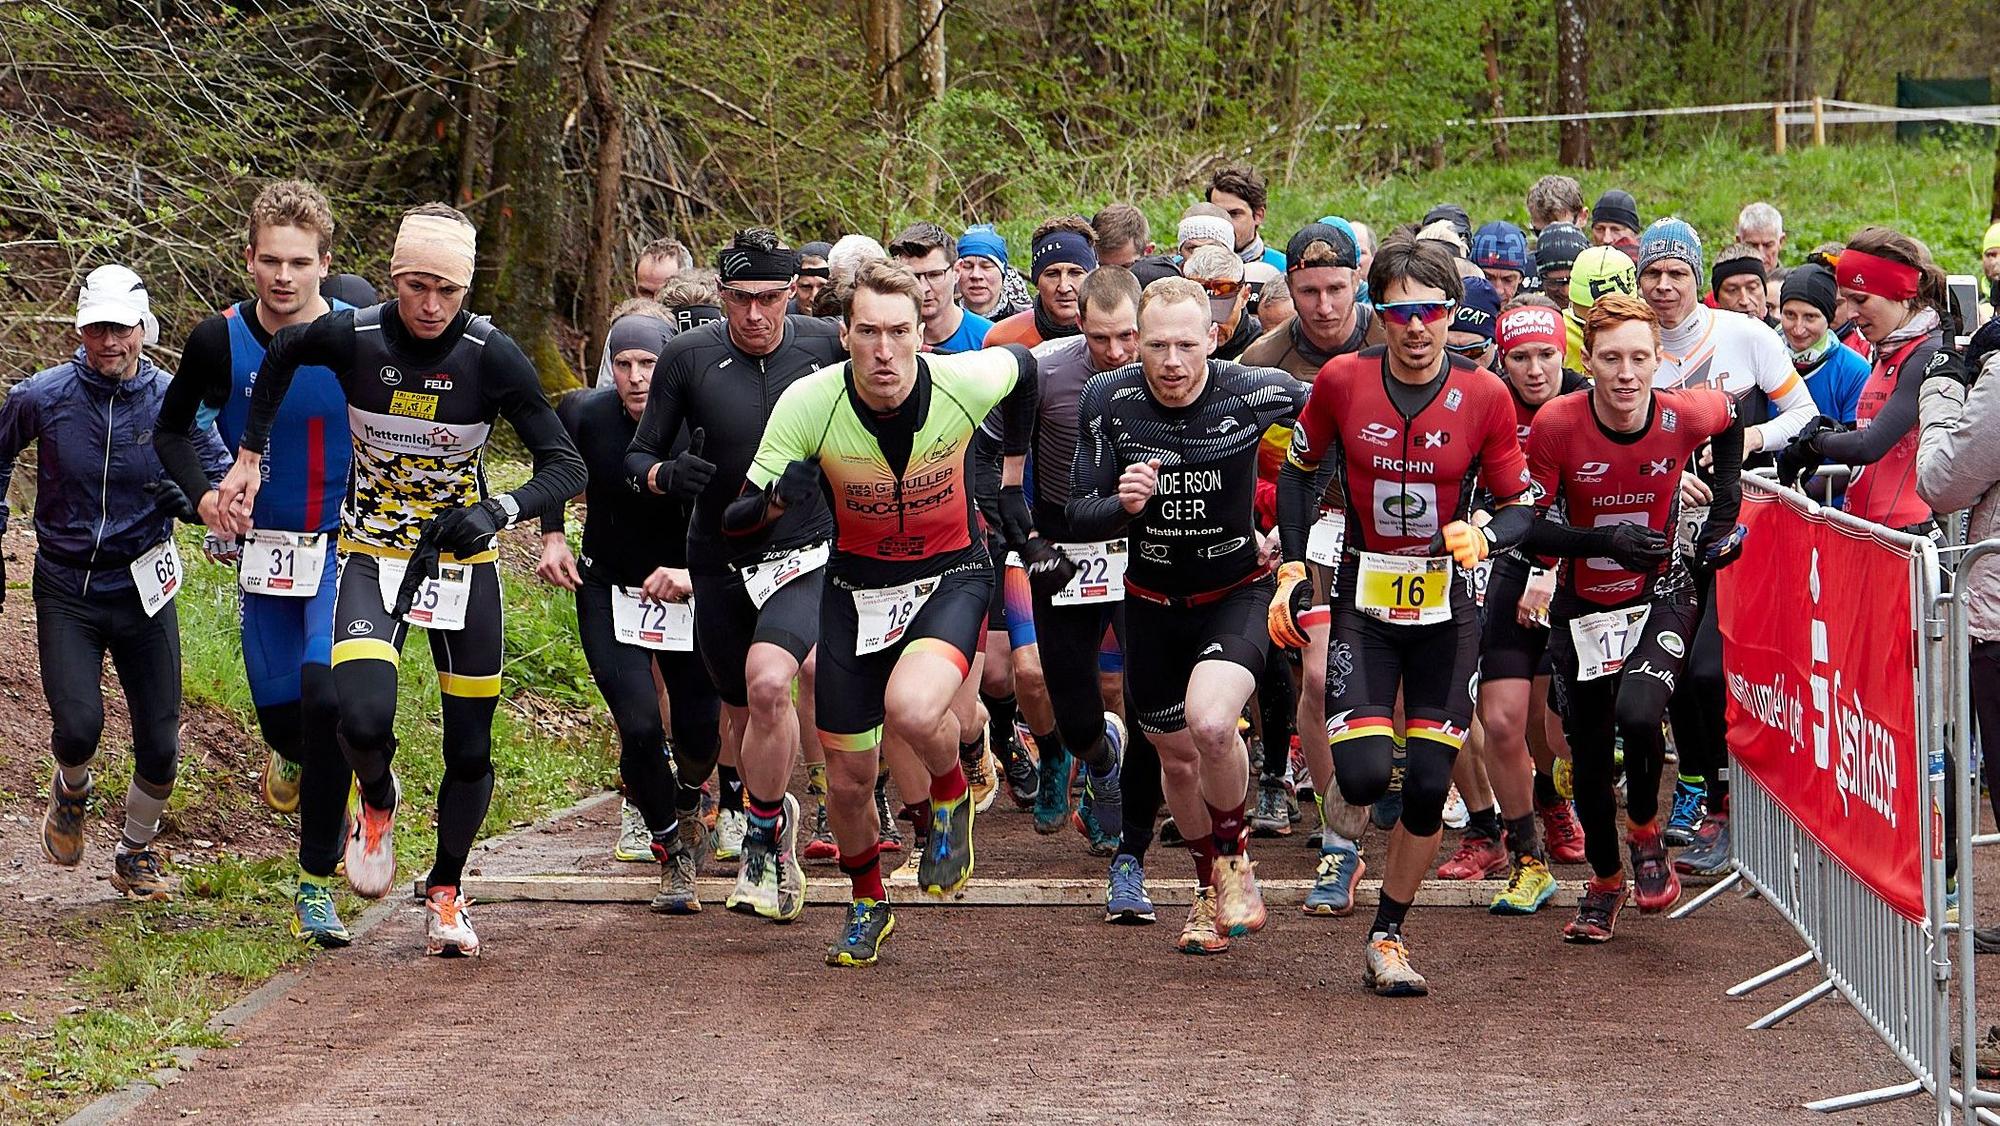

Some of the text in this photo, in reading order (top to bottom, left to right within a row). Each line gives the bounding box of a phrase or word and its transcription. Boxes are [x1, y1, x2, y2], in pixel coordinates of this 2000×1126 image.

[1501, 310, 1555, 335] HOKA
[411, 394, 435, 402] POWER
[424, 379, 453, 391] FELD
[1373, 455, 1434, 474] FROHN
[846, 483, 954, 515] BoConcept
[1592, 493, 1655, 507] HOLDER
[154, 551, 175, 584] 68
[269, 548, 294, 577] 31
[772, 556, 801, 579] 25
[944, 562, 983, 577] mobile
[1079, 557, 1109, 585] 22
[1392, 575, 1425, 607] 16
[638, 603, 666, 631] 72
[888, 600, 913, 630] 18
[1599, 629, 1629, 659] 17
[1833, 669, 1897, 829] Sparkasse
